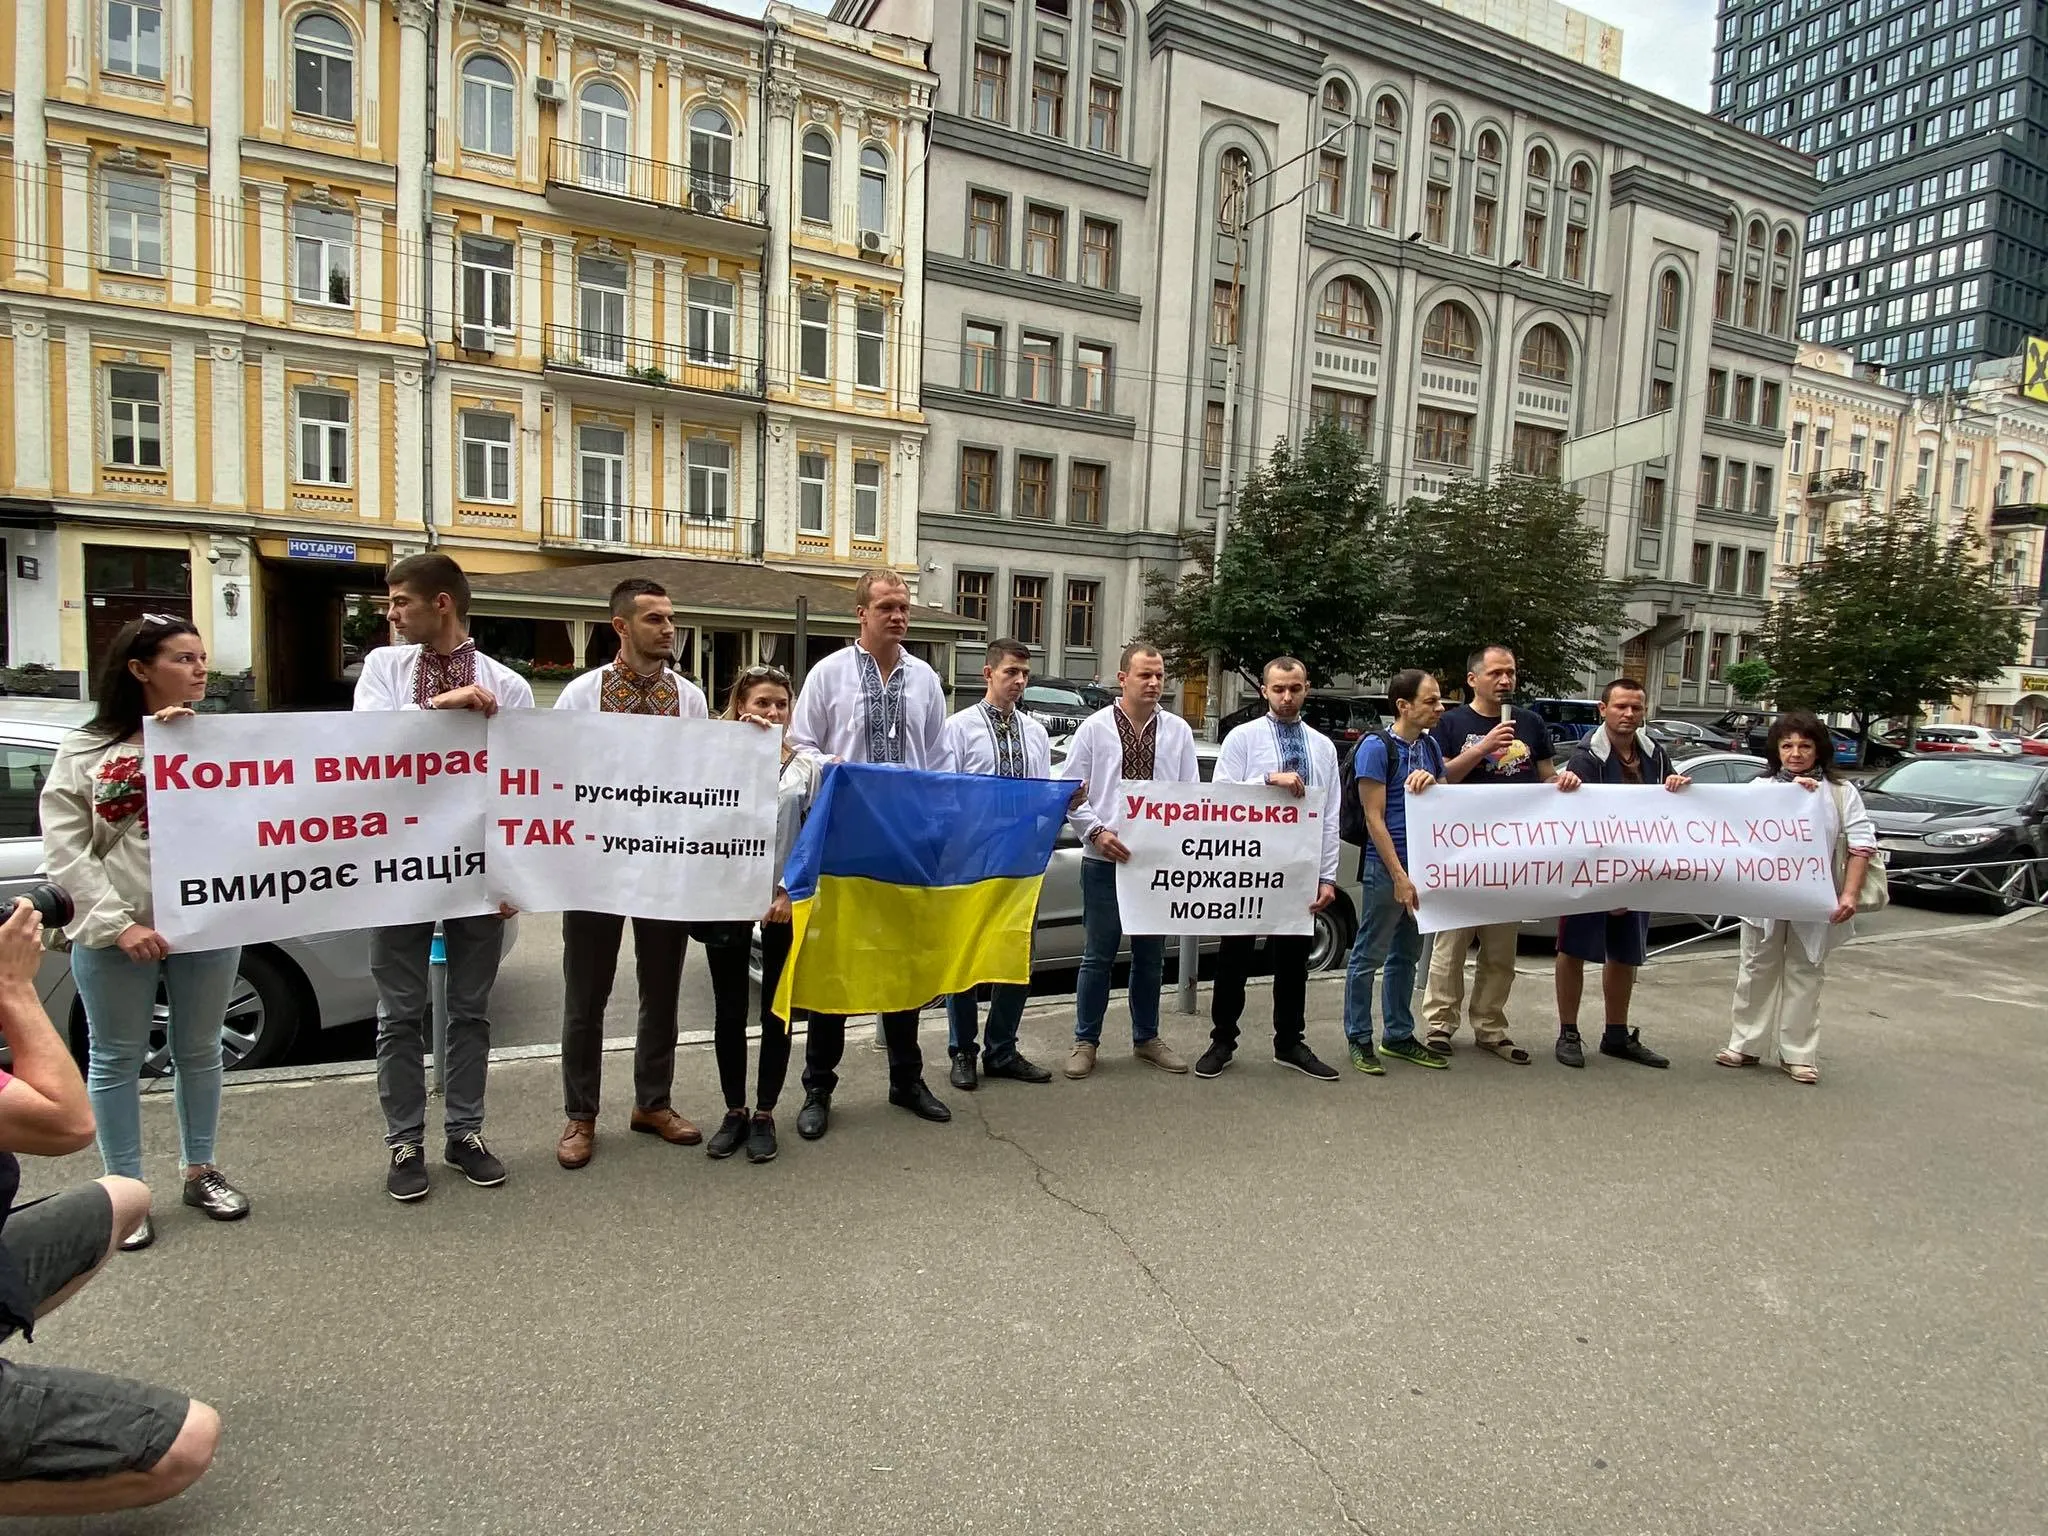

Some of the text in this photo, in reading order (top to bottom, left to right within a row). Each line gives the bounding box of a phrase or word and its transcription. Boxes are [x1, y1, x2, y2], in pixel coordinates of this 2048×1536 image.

[290, 541, 354, 555] НОТАРІУС
[227, 559, 235, 572] 7
[153, 753, 294, 791] Коли
[500, 768, 540, 796] НІ
[575, 783, 740, 809] русифікації!!!
[1126, 795, 1298, 827] Українська
[257, 811, 419, 847] мова -
[497, 818, 575, 847] ТАК
[602, 835, 767, 859] українізації!!!
[1432, 814, 1813, 848] КОНСТИТУЦІЙНИЙ СУД ХОЧЕ
[1181, 838, 1262, 860] єдина
[180, 846, 486, 906] вмирає нація
[1151, 869, 1285, 893] державна
[1425, 857, 1826, 890] ЗНИЩИТИ ДЕРЖАВНУ МОВУ?!
[1170, 896, 1264, 919] мова!!!
